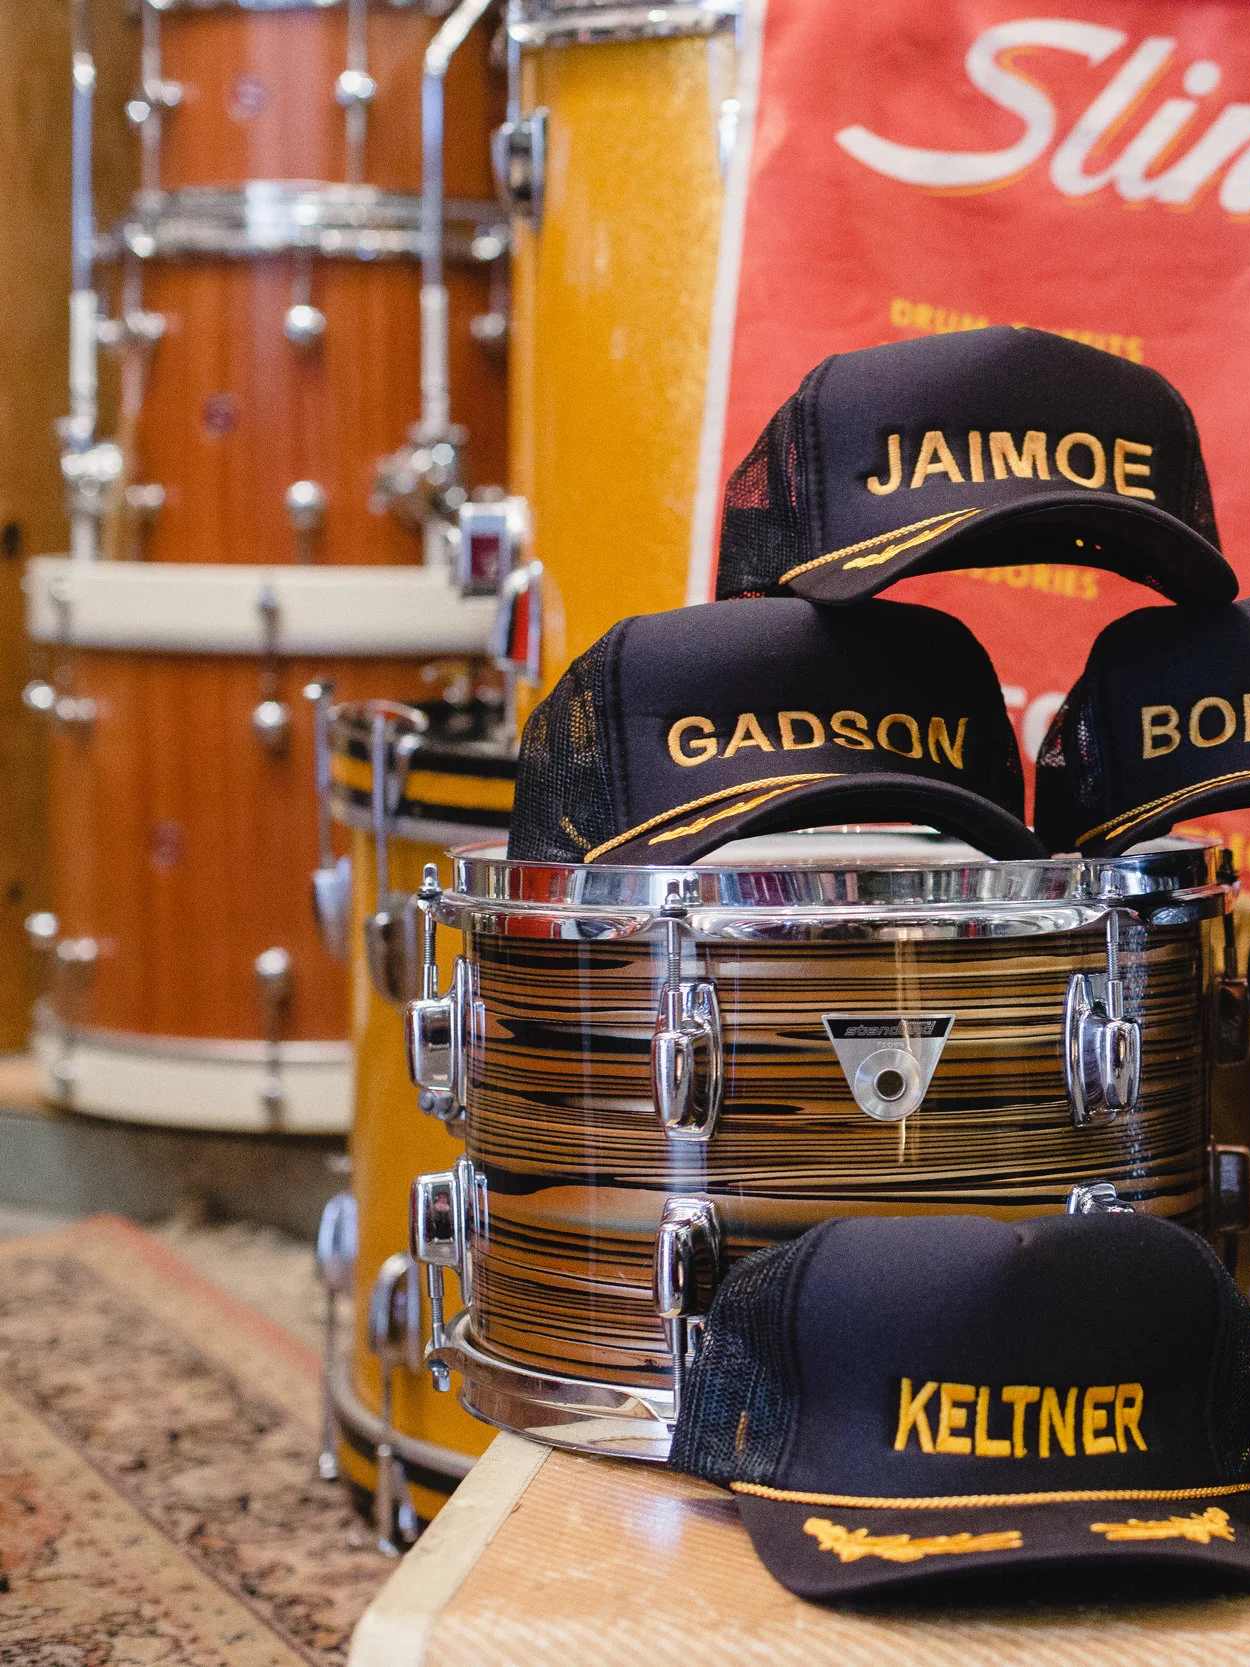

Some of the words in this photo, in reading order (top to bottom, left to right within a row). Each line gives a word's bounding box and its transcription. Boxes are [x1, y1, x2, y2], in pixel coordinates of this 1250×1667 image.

[866, 430, 1156, 501] JAIMOE
[667, 710, 968, 770] GADSON
[893, 1377, 1148, 1459] KELTNER
